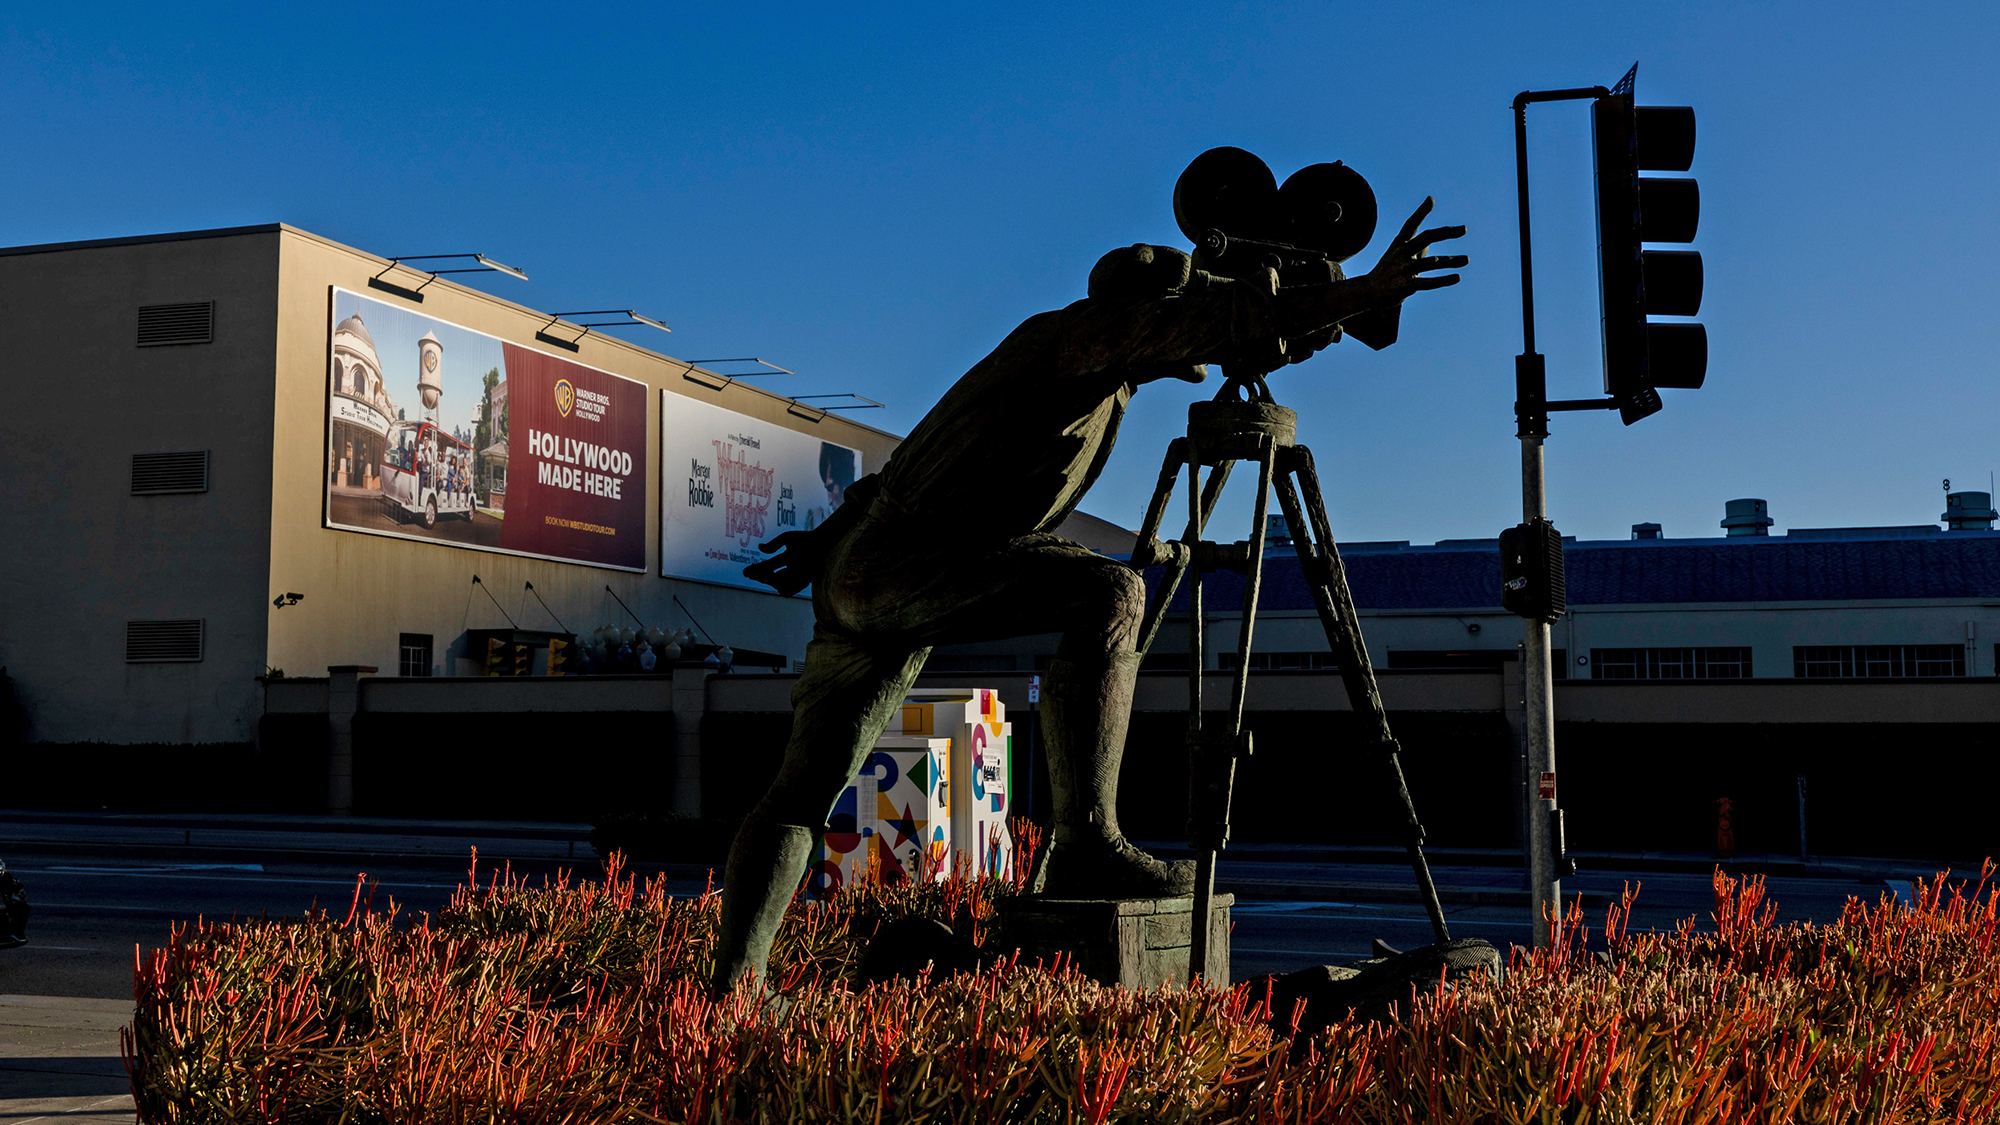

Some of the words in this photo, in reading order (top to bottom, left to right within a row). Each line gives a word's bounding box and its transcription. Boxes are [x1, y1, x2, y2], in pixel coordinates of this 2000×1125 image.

[576, 387, 597, 402] WARNER
[576, 398, 593, 412] STUDIO
[593, 403, 605, 415] TOUR
[576, 409, 600, 422] HOLLYWOOD
[529, 428, 632, 476] HOLLYWOOD
[538, 461, 582, 492] MADE
[691, 458, 711, 482] Margot
[688, 478, 714, 508] Robbie
[779, 482, 793, 500] Jacob
[777, 499, 796, 526] Elordi
[545, 515, 559, 526] BOOK
[559, 518, 570, 528] NOW
[570, 521, 616, 536] WBSTUDIOTOUR.COM
